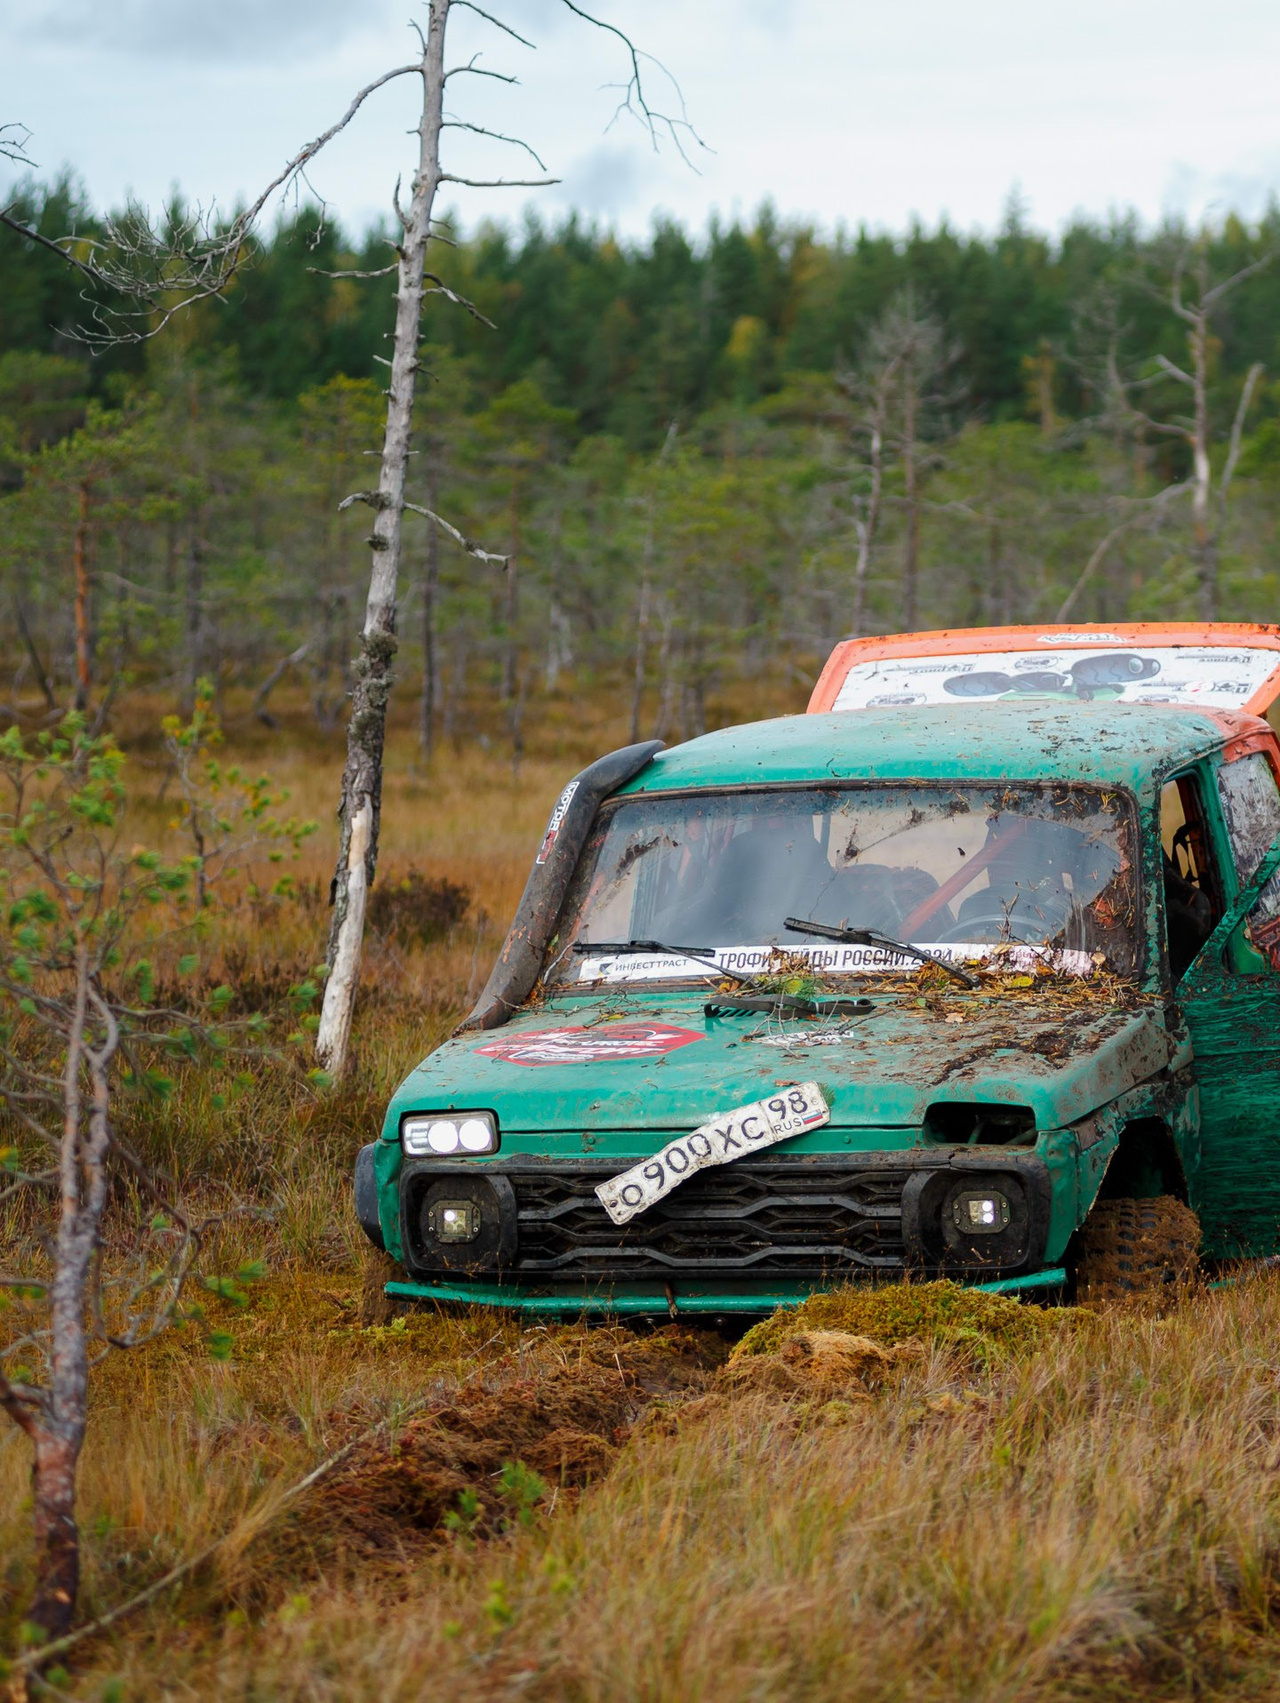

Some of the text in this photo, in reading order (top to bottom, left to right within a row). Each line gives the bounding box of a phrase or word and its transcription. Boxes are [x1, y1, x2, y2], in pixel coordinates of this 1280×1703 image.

[616, 959, 688, 972] ИНВЕСТТРАСТ
[768, 1091, 808, 1119] 98
[774, 1117, 803, 1133] RUS
